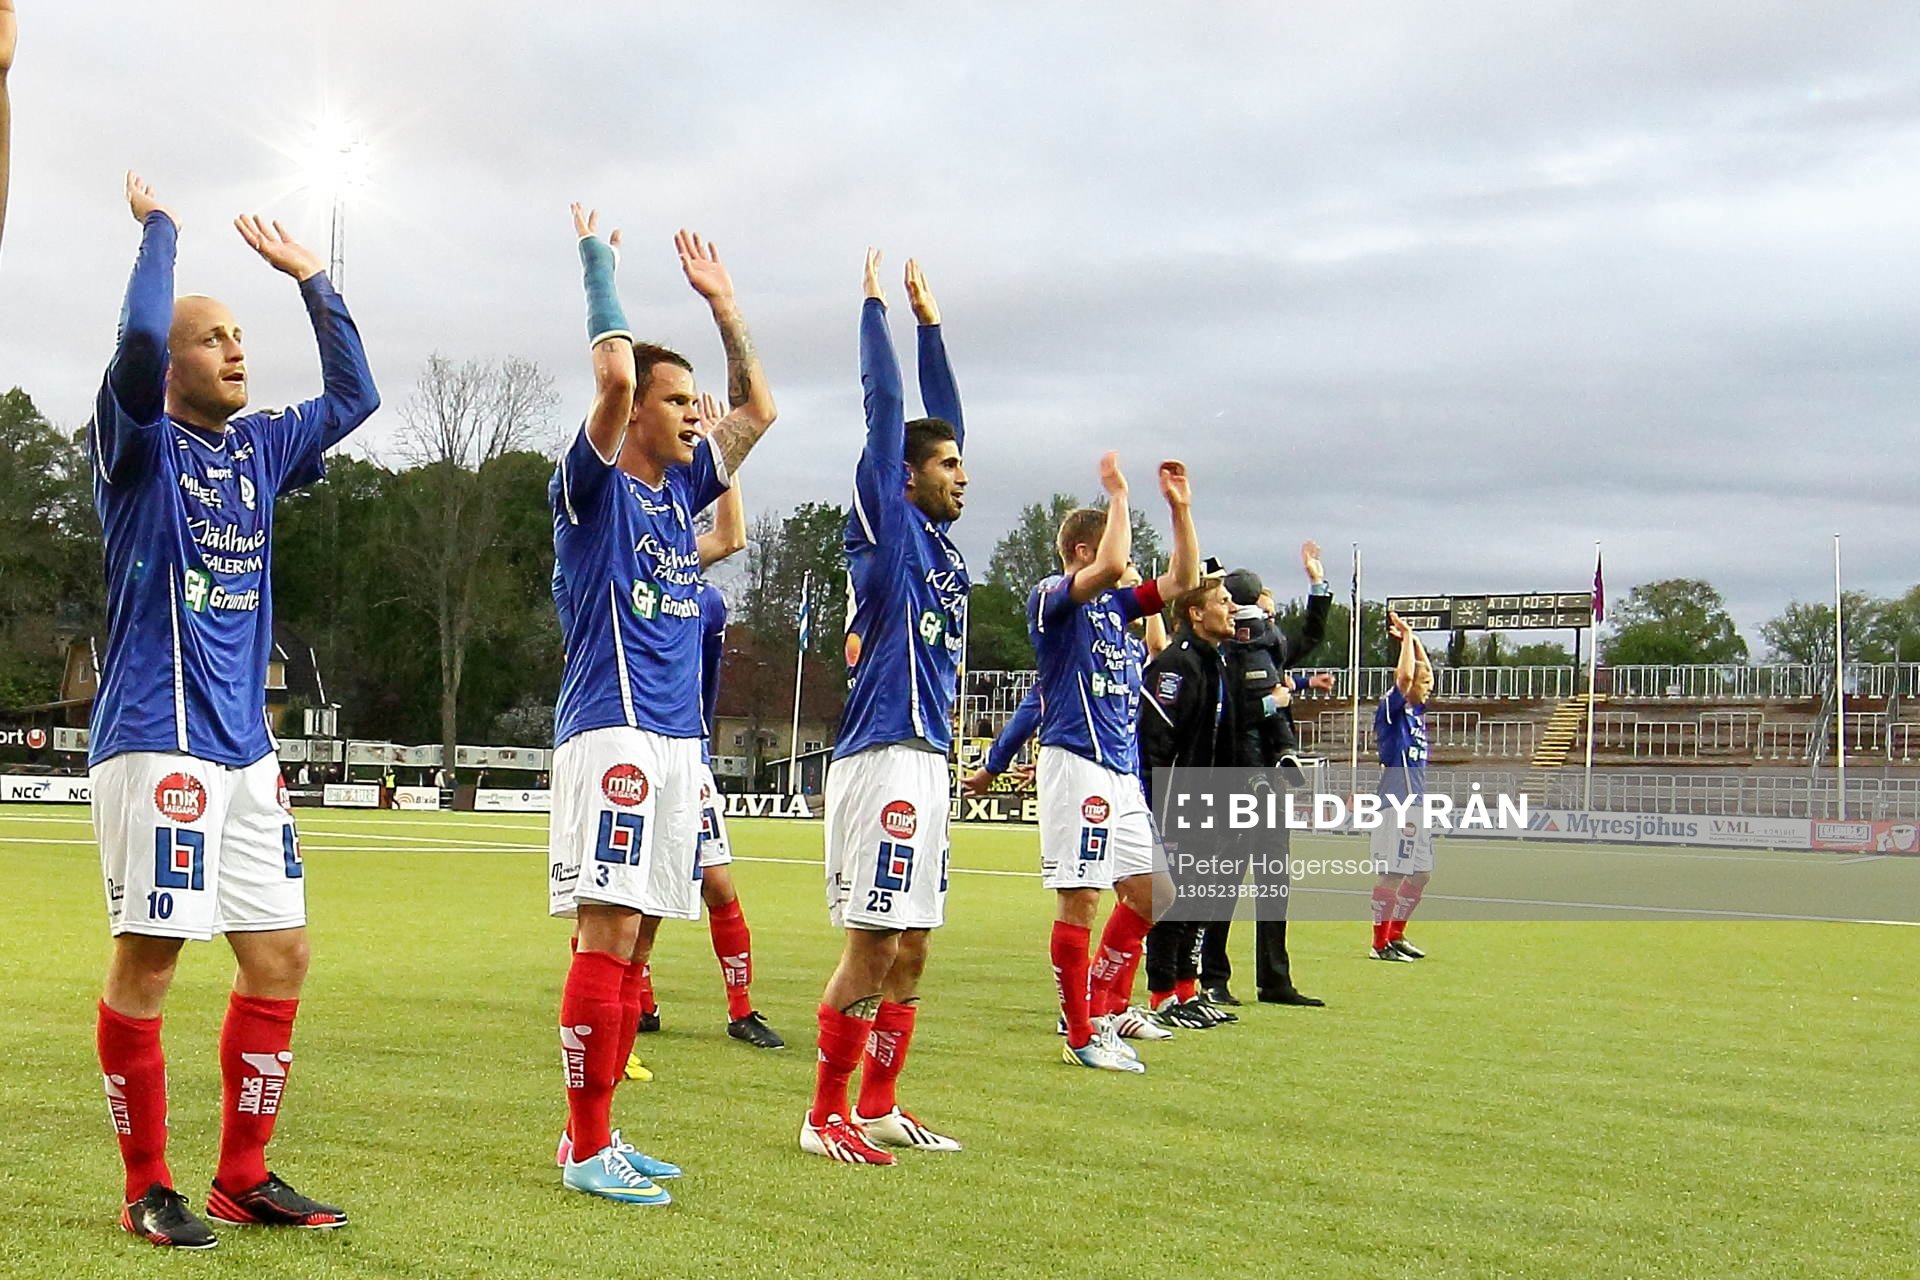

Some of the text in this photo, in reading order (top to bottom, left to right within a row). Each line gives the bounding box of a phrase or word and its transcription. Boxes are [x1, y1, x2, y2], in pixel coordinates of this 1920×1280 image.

[12, 787, 42, 798] NCC
[608, 776, 643, 794] mix
[886, 811, 916, 827] mix
[1566, 813, 1698, 840] Myresjöhus
[1713, 820, 1755, 834] VML
[596, 865, 609, 887] 3
[1078, 863, 1086, 877] 5
[147, 891, 174, 919] 10
[866, 890, 893, 913] 25
[261, 1078, 284, 1115] INTER
[111, 1098, 132, 1135] INTER
